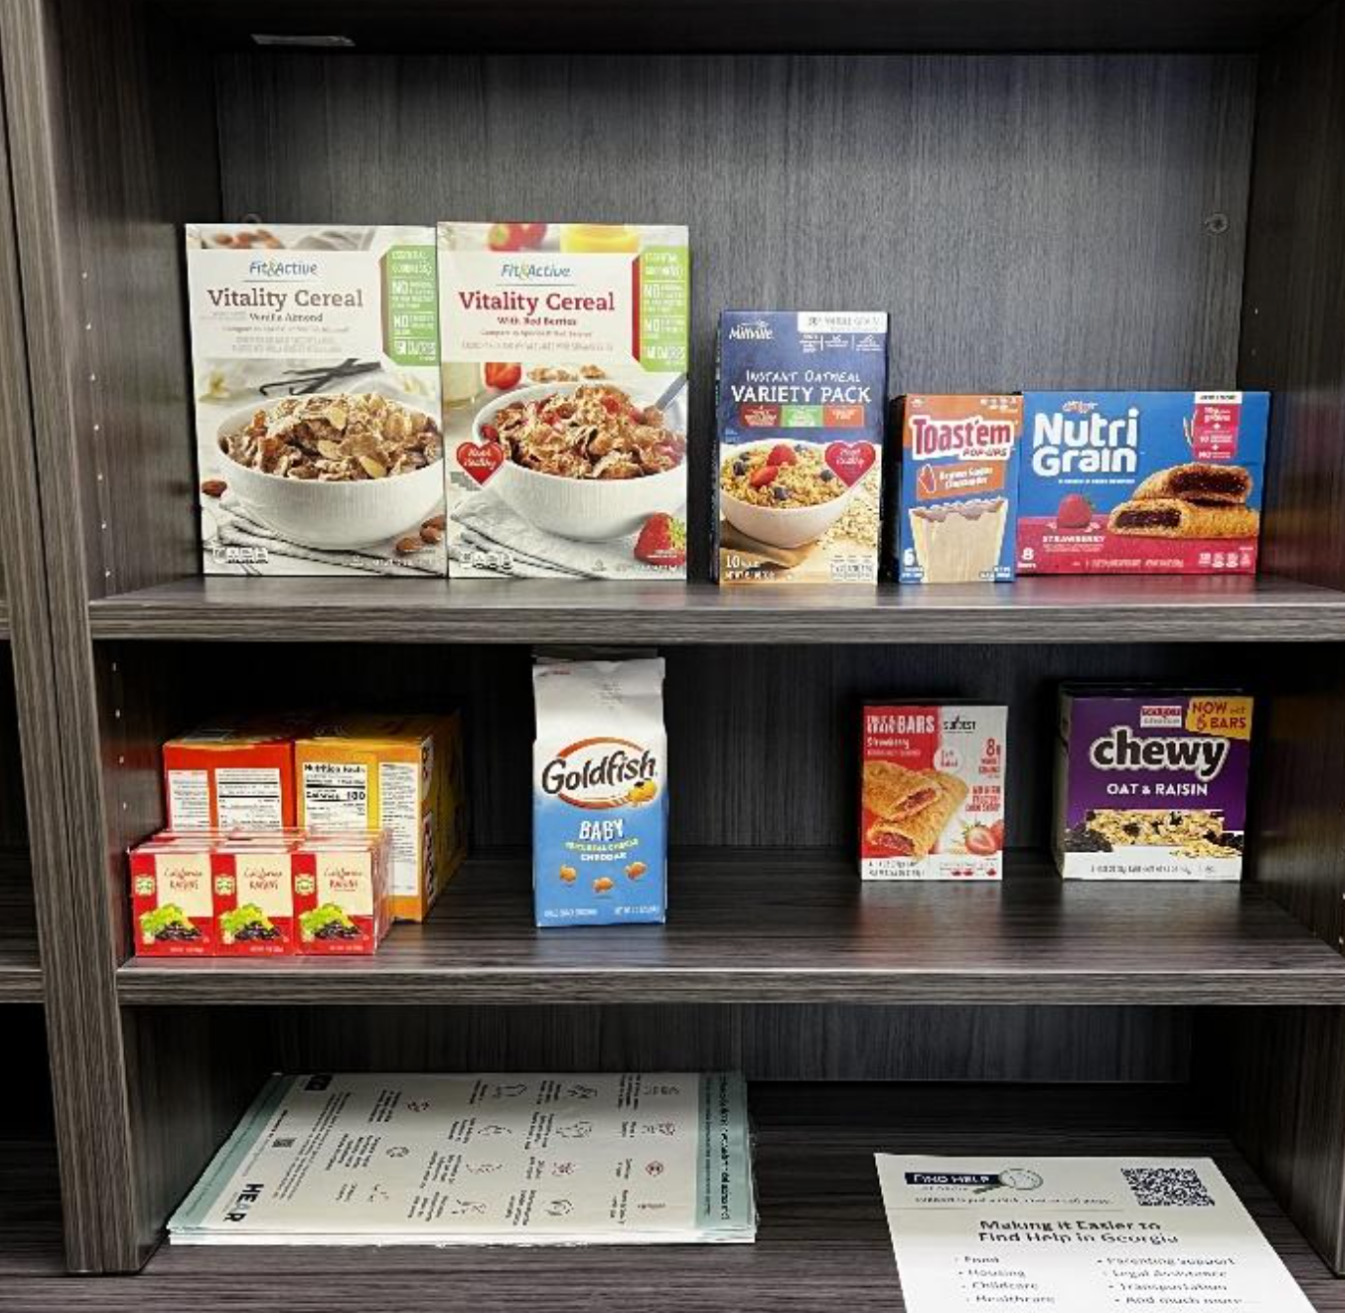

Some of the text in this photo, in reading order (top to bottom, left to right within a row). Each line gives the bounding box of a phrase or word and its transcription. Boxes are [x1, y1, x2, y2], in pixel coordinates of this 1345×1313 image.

[207, 288, 363, 311] Vitality Cereal
[458, 291, 615, 315] Vitality Cereal
[746, 370, 795, 383] INSTANT
[731, 386, 872, 403] VARIETY PACK
[913, 416, 1011, 456] Toast'em
[1033, 408, 1140, 449] Nutri
[1032, 445, 1137, 476] Grain
[1022, 549, 1034, 560] 8
[1192, 701, 1228, 714] NOW
[897, 716, 934, 734] BARS
[1210, 717, 1247, 729] BARS
[1093, 729, 1226, 777] chewy
[542, 750, 656, 795] Goldfish
[1107, 783, 1208, 795] OAT & RAISIN
[579, 818, 624, 841] BABY
[914, 1173, 990, 1183] FIND HELP
[980, 1220, 1053, 1231] Making
[1076, 1221, 1134, 1230] Easier
[1139, 1221, 1161, 1230] to
[979, 1233, 1178, 1245] Find Help in Georgia
